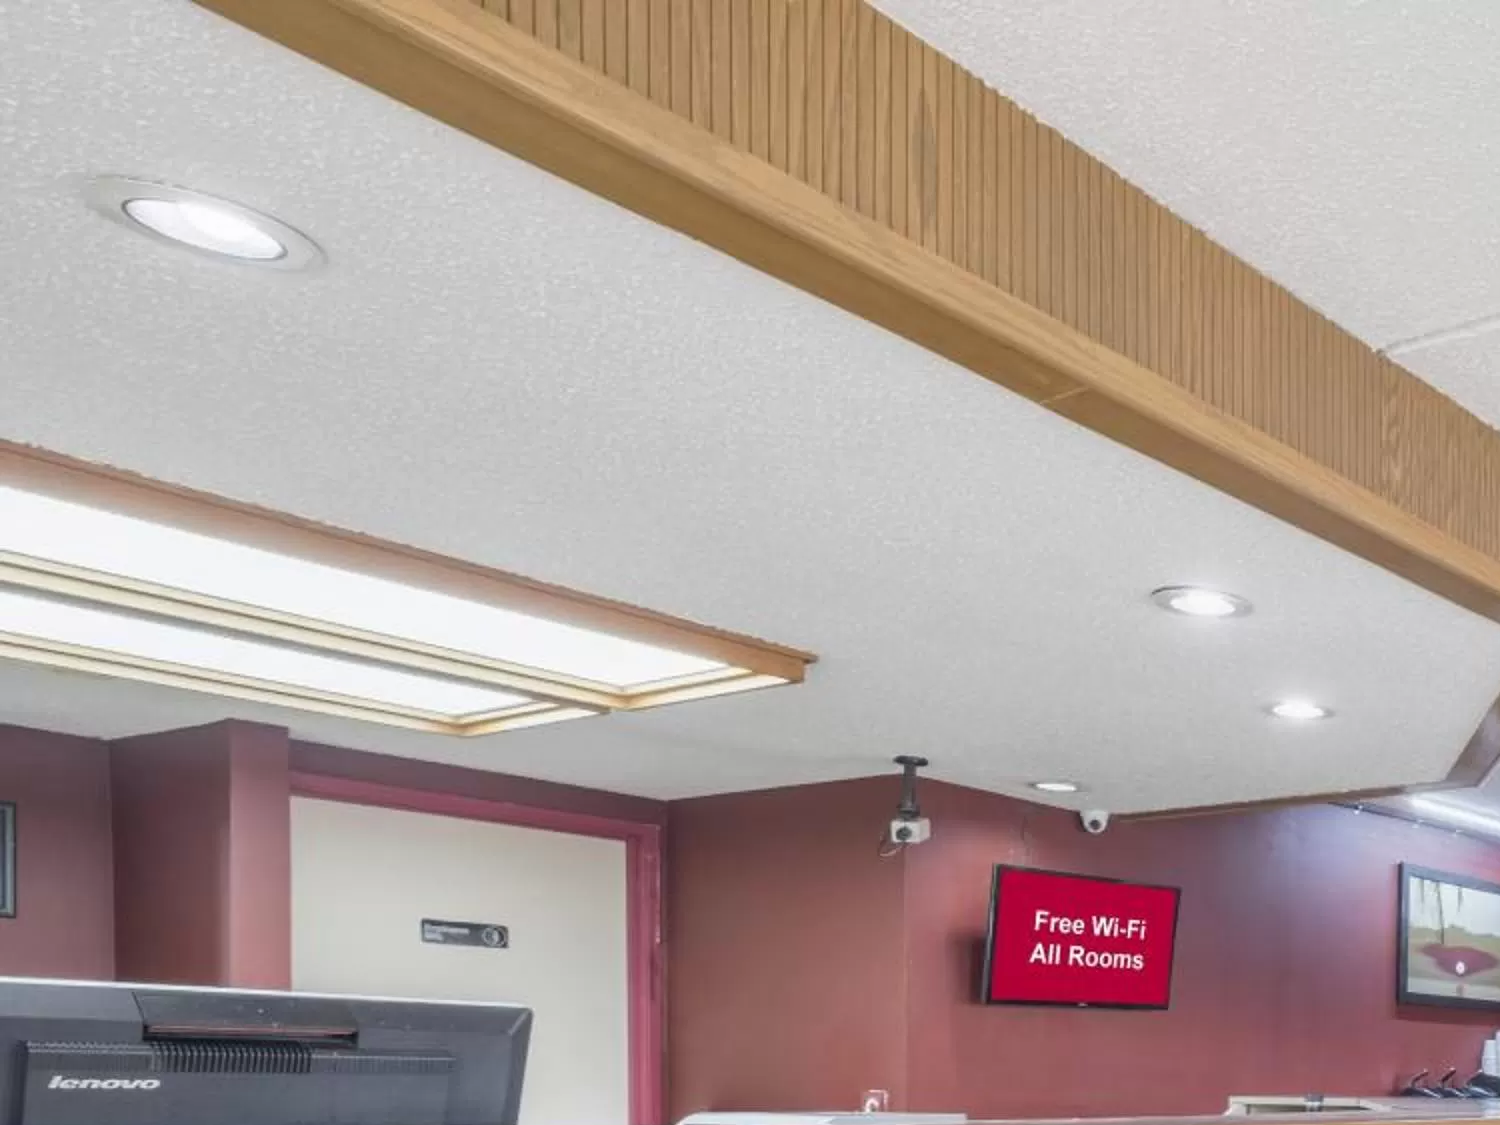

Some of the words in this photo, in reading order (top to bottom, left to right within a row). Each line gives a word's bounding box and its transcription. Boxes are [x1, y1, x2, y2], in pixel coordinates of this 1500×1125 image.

[1033, 909, 1086, 935] Free
[1091, 914, 1147, 941] Wi-Fi
[1028, 941, 1062, 966] All
[1067, 944, 1146, 971] Rooms
[47, 1075, 161, 1090] lenovo
